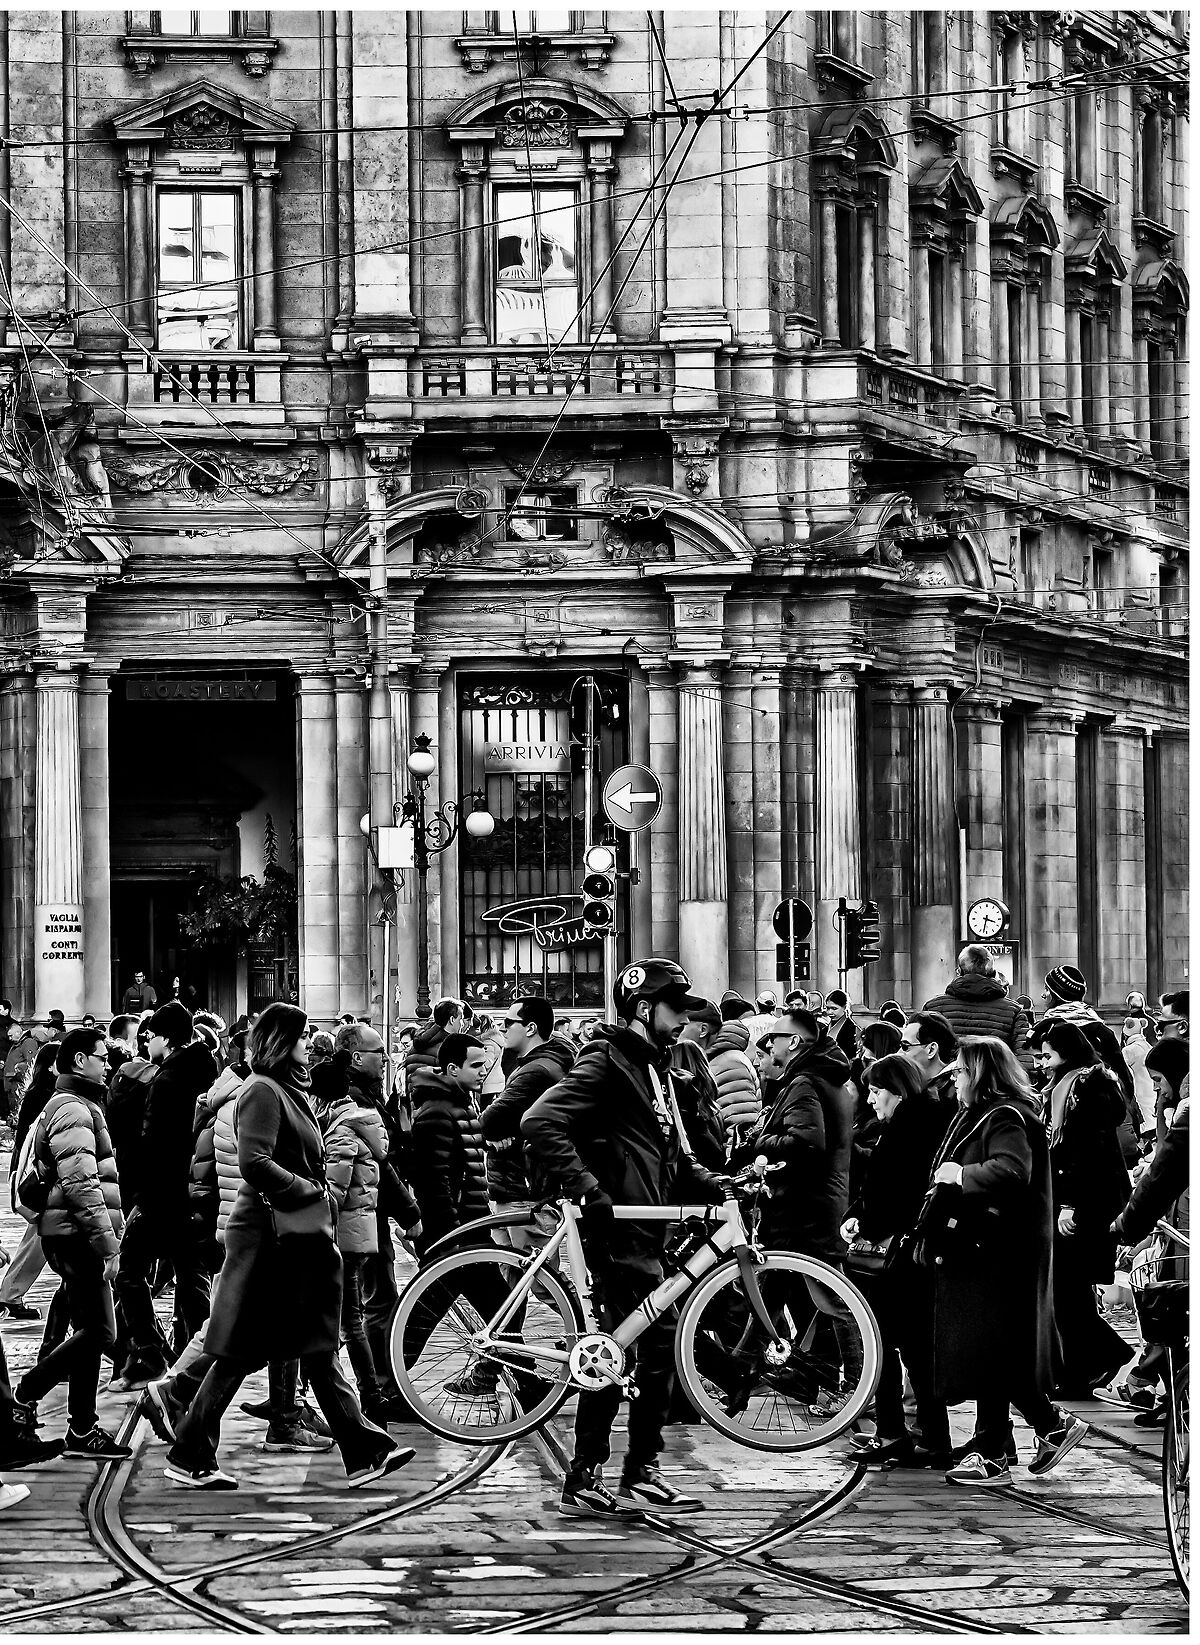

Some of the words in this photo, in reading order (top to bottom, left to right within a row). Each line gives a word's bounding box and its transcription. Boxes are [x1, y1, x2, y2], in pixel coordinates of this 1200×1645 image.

[141, 684, 262, 698] ROASTERY
[49, 913, 79, 922] VAGLIA
[50, 940, 78, 949] CONTI
[629, 969, 639, 985] 8
